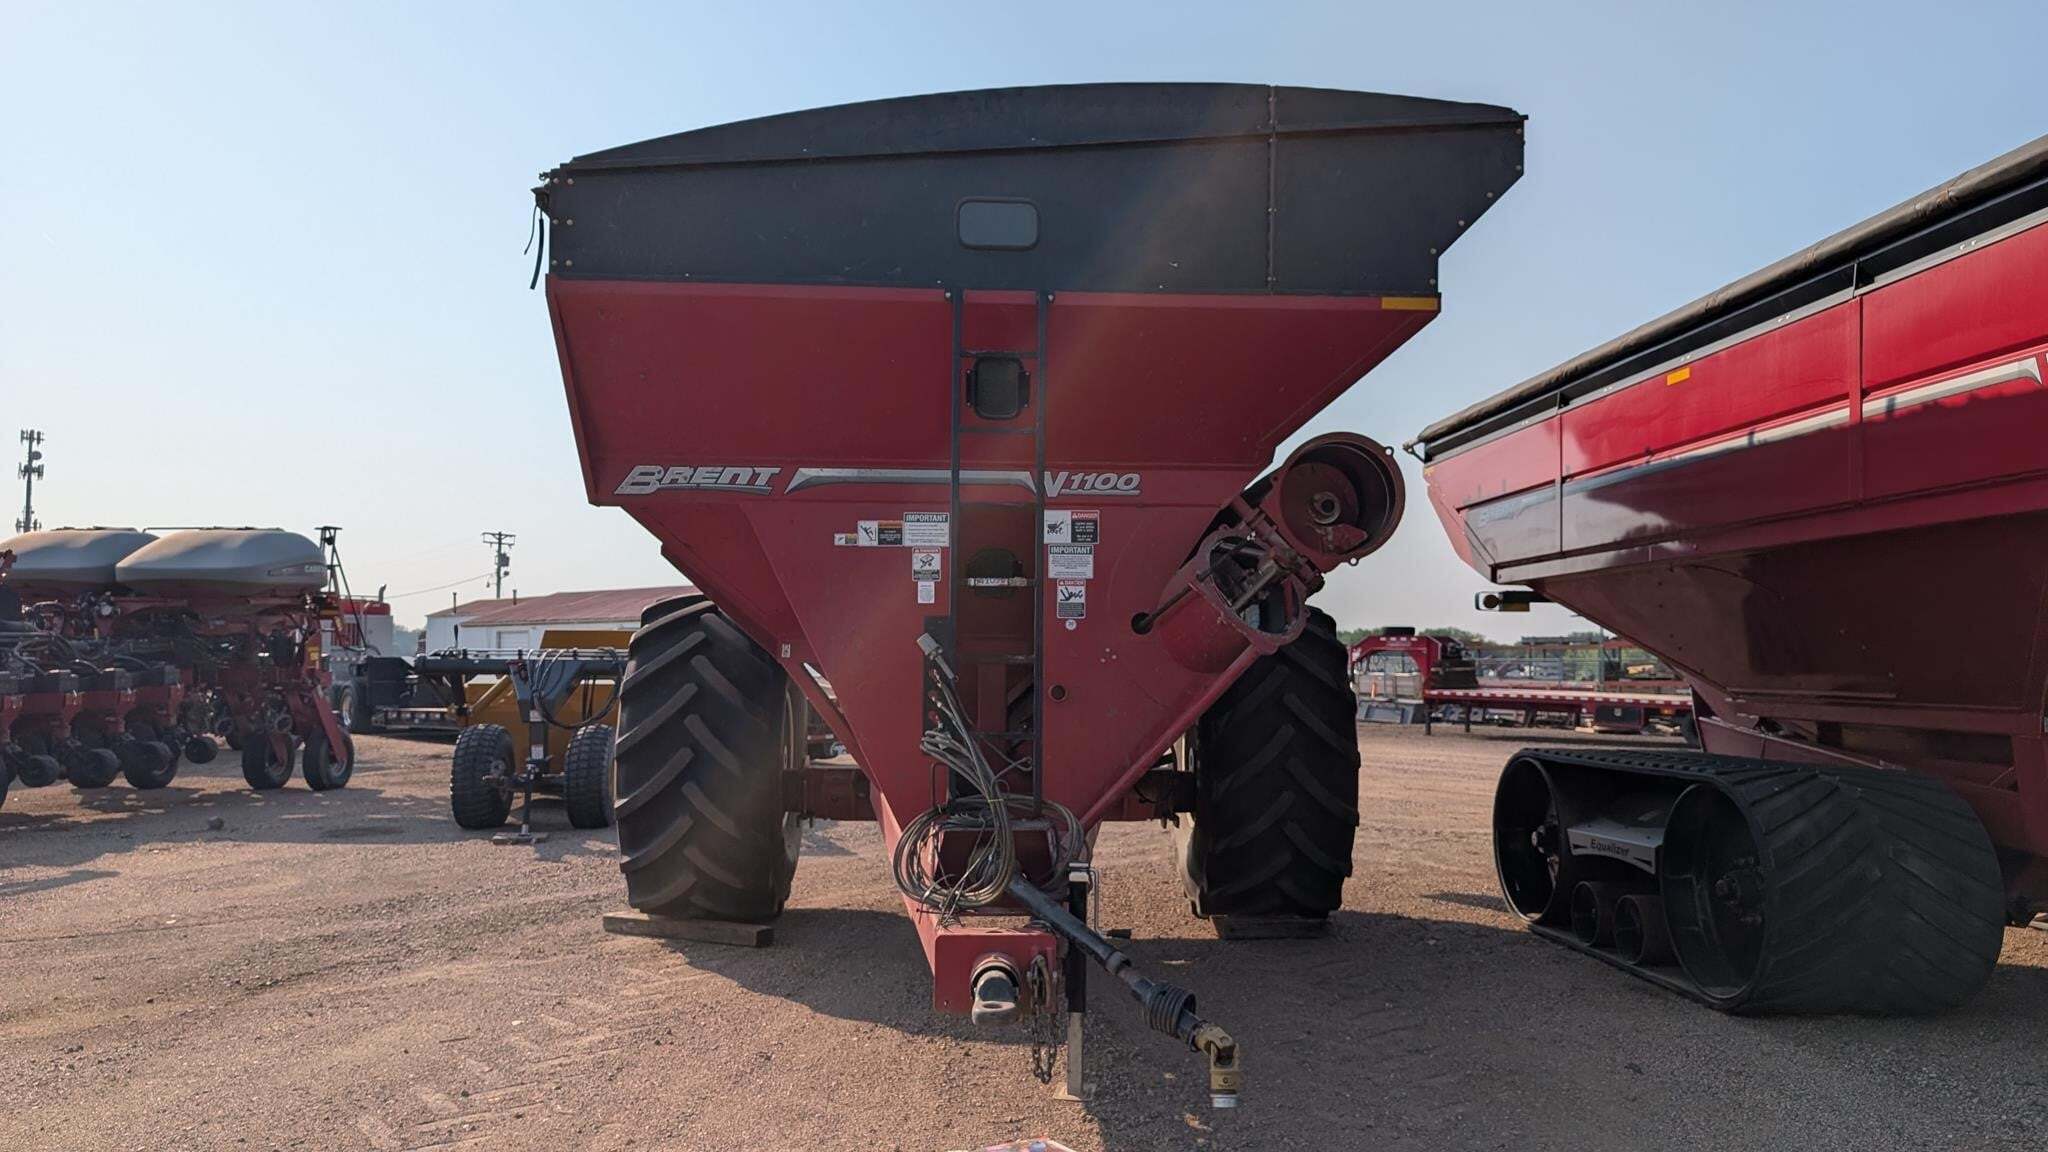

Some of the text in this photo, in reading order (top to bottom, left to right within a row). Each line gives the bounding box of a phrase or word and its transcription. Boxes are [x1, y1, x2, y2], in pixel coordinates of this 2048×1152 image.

[614, 465, 782, 495] BRENT
[1044, 471, 1140, 498] V1100
[906, 514, 947, 522] IMPORTANT
[1050, 546, 1091, 554] IMPORTANT
